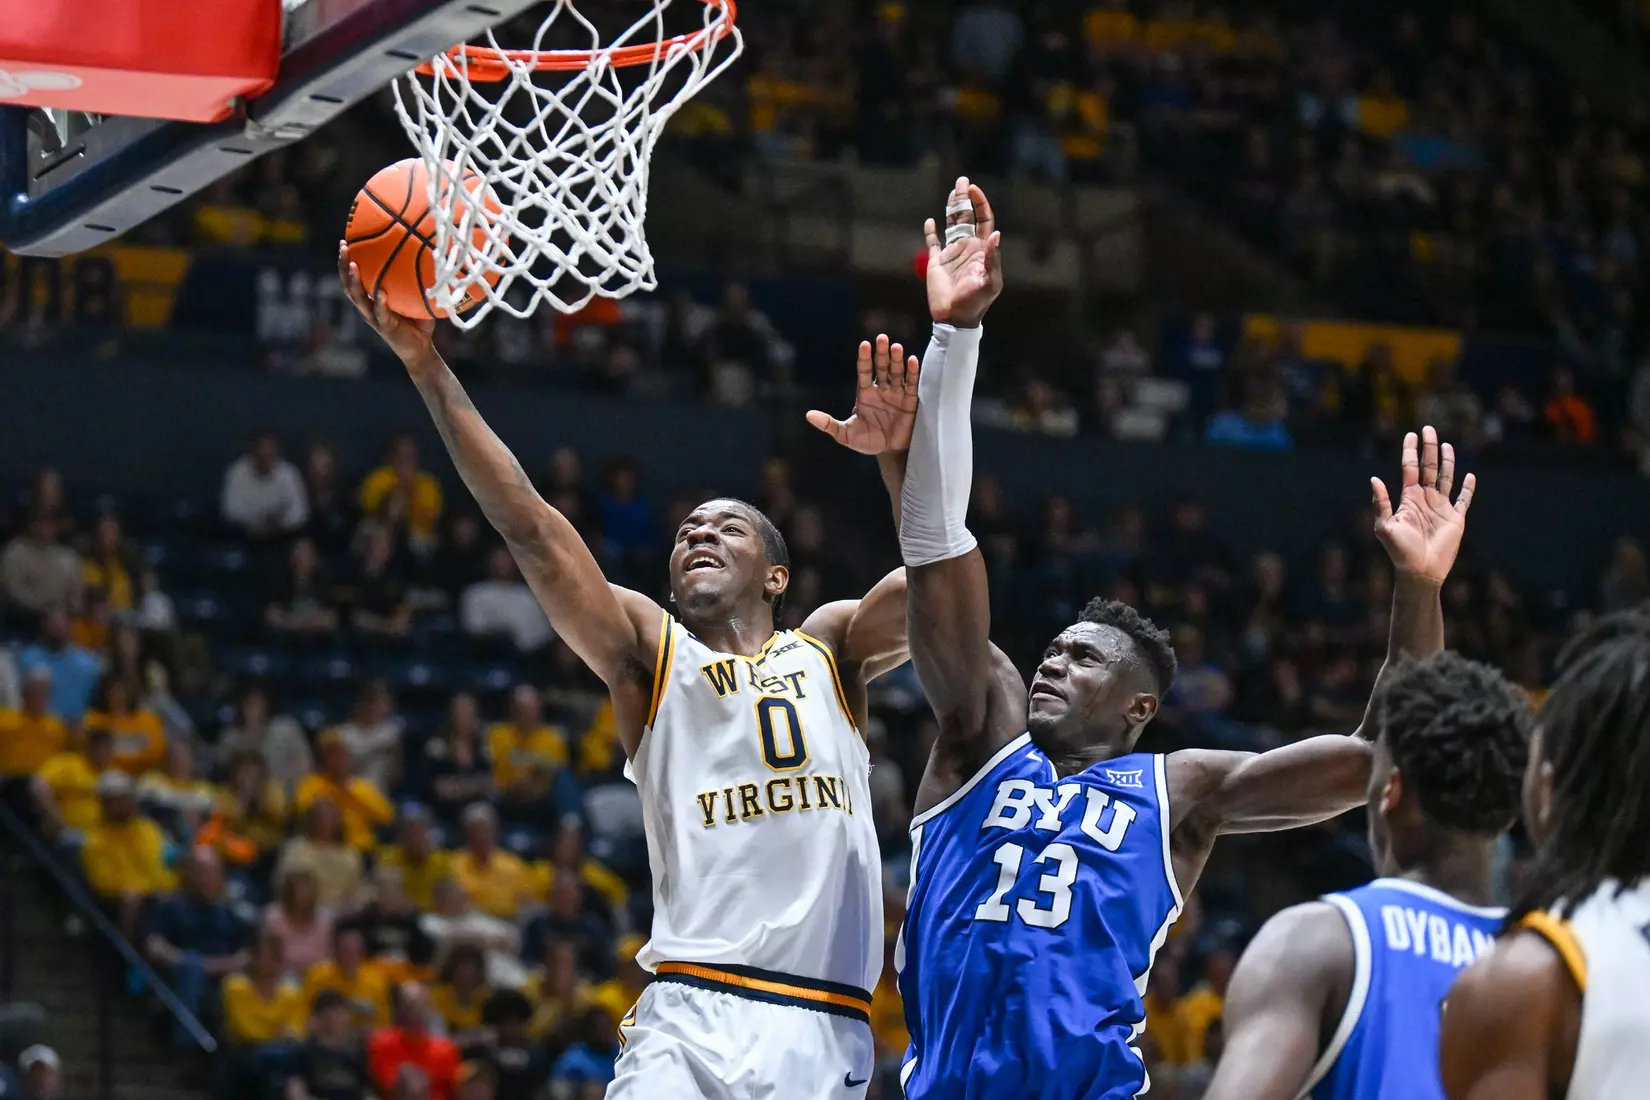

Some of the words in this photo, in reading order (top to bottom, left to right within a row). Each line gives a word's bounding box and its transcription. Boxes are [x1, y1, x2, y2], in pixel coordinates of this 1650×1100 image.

[754, 694, 809, 772] 0
[981, 779, 1137, 851] BYU
[974, 842, 1079, 928] 13
